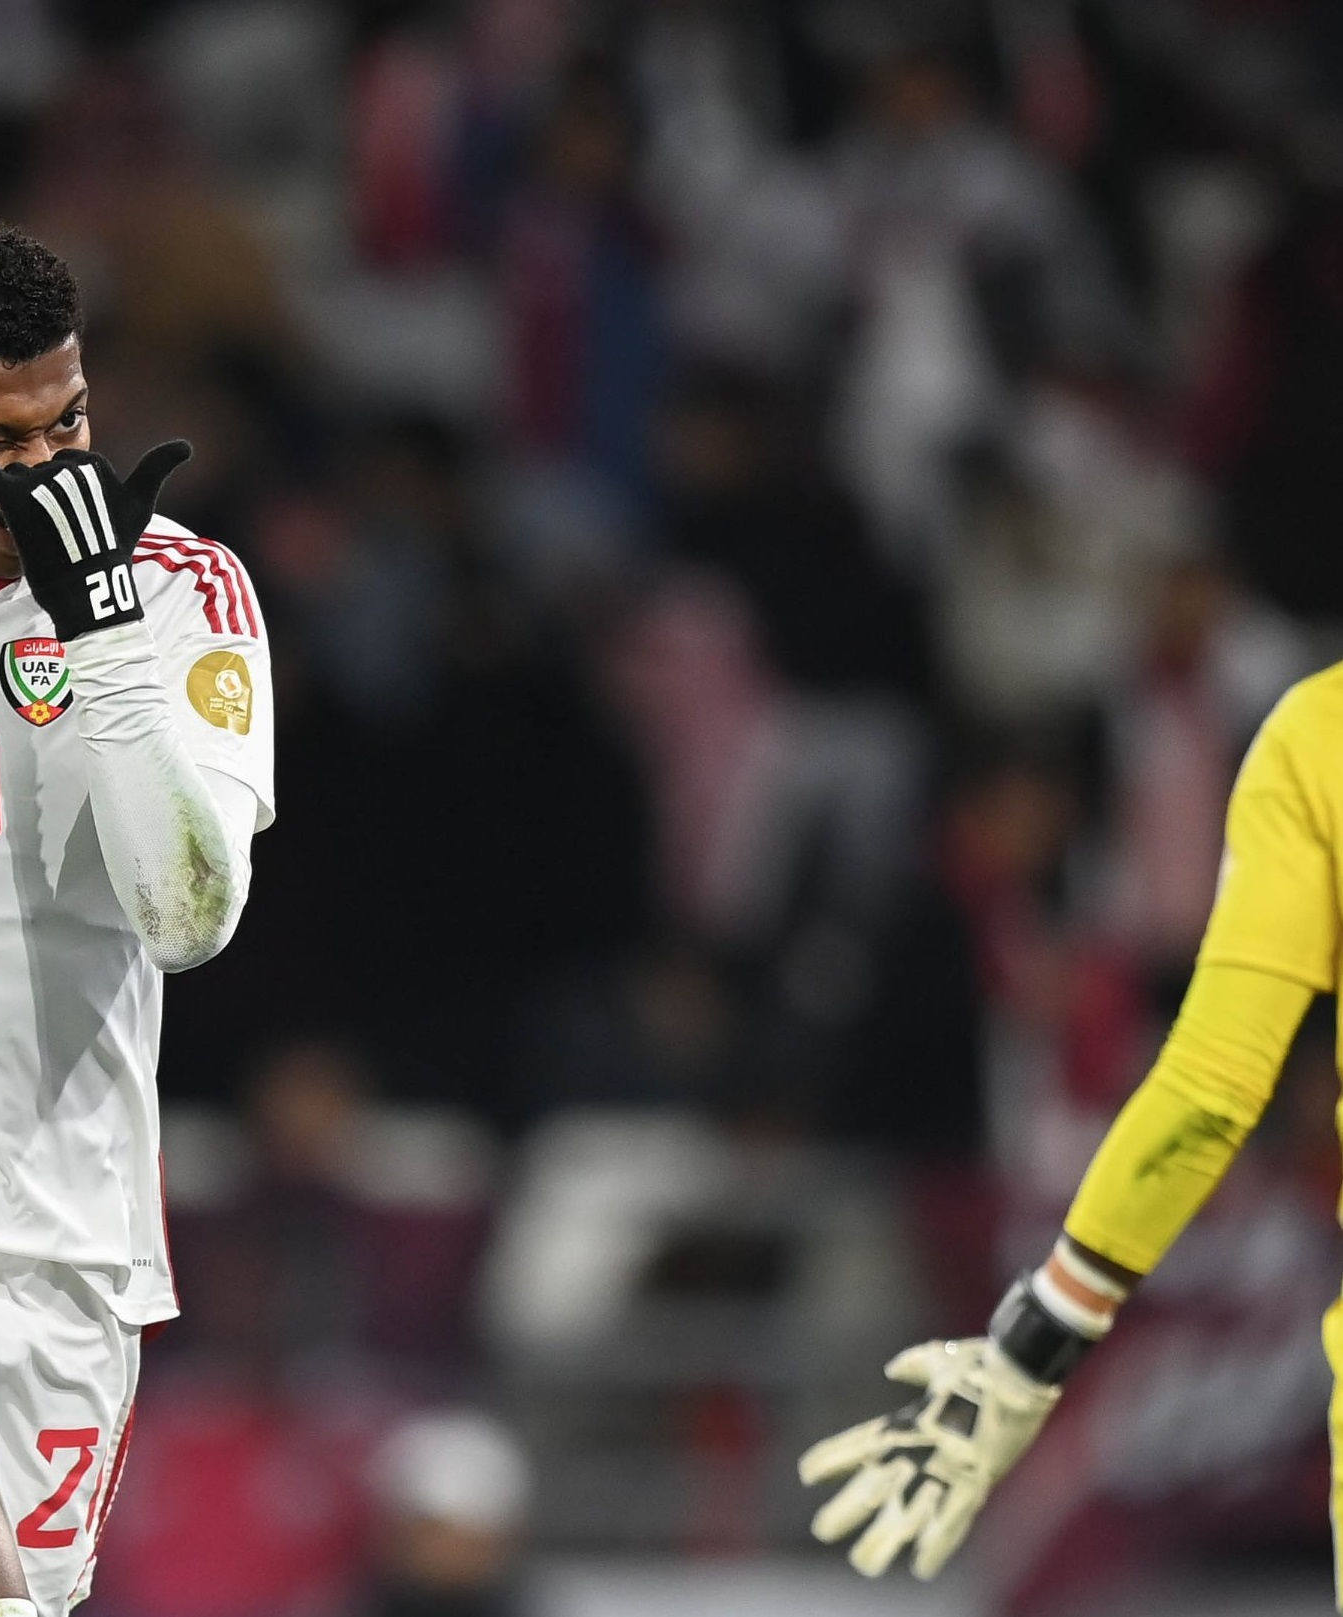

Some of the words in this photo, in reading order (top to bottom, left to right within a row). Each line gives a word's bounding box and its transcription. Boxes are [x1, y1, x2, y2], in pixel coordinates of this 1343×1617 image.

[86, 563, 135, 620] 20
[22, 661, 60, 674] UAE
[31, 675, 51, 686] FA
